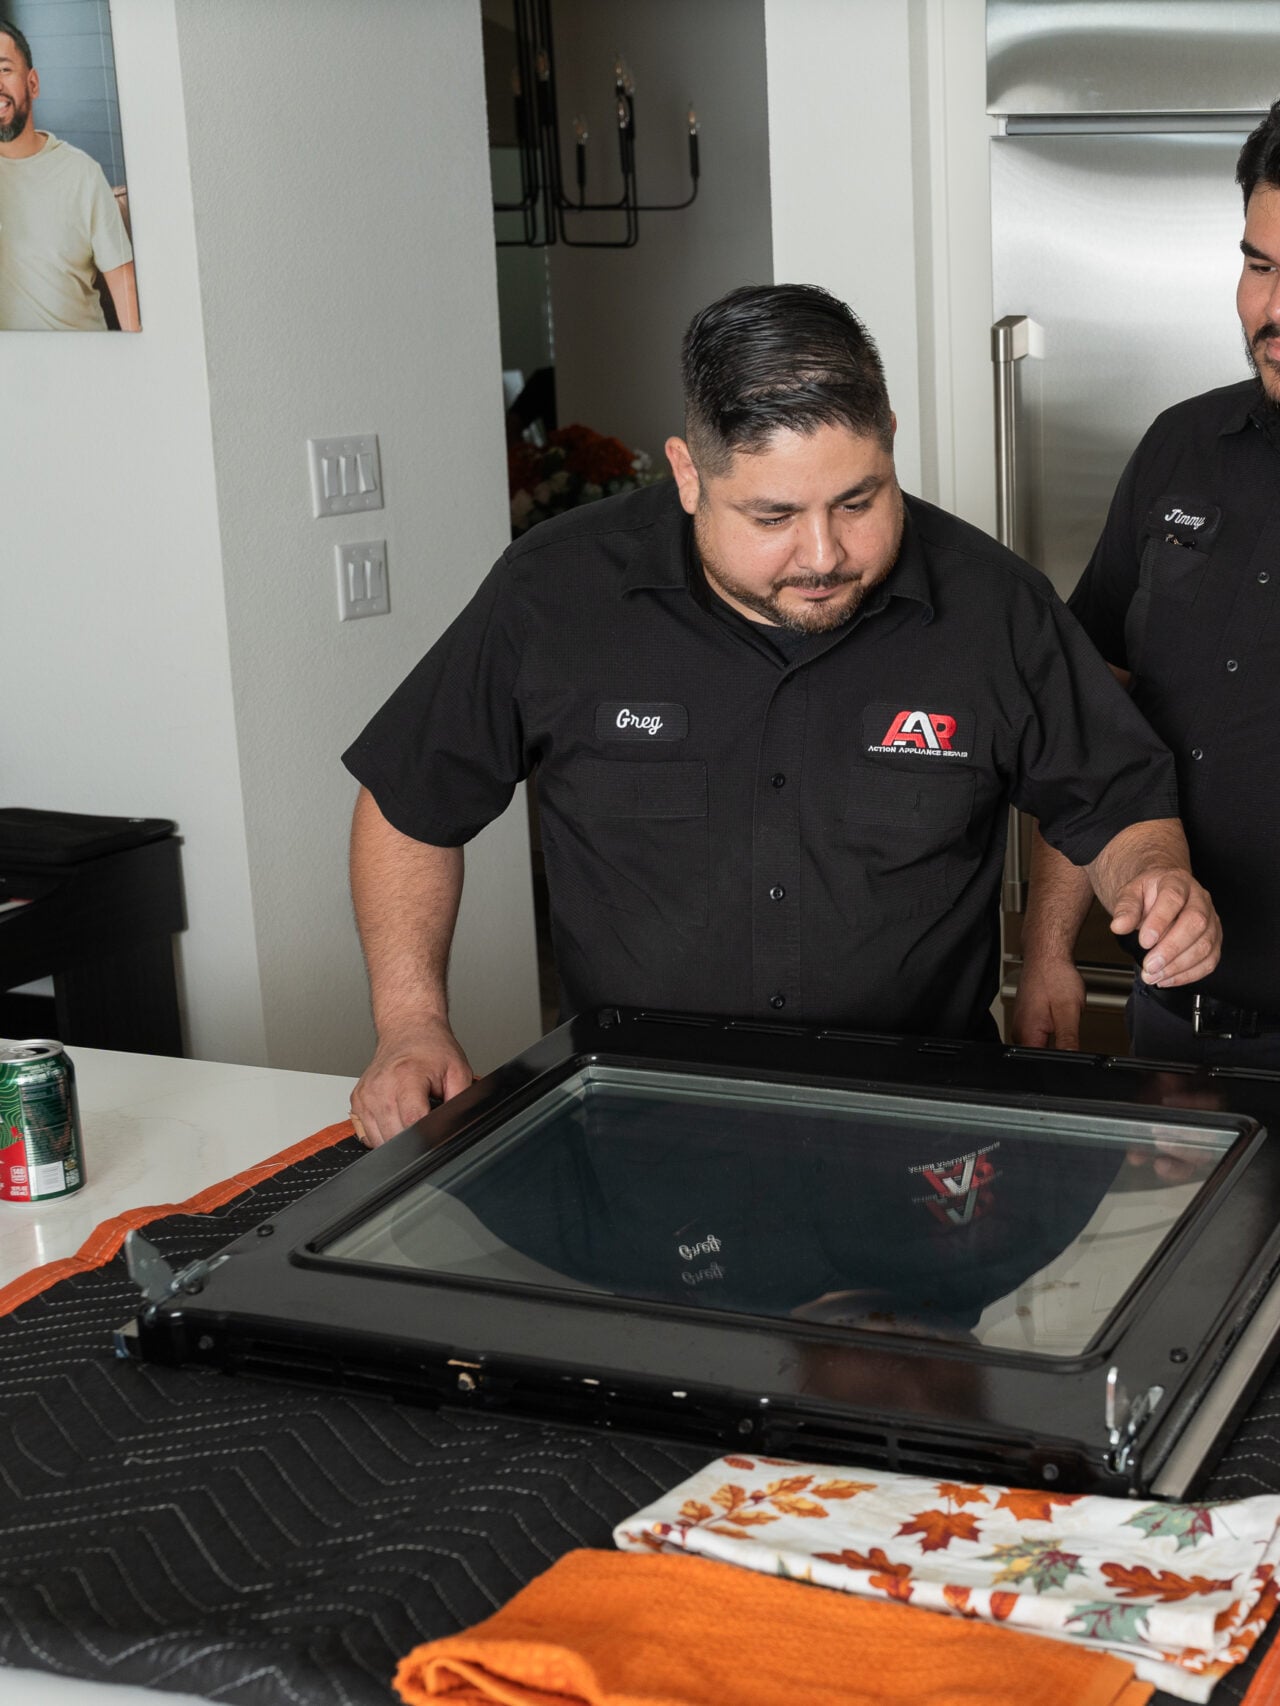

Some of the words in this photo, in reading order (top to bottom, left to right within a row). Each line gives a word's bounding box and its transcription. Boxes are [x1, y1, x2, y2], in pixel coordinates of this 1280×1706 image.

[1164, 508, 1206, 530] Jimmy
[616, 708, 663, 735] Greg
[881, 710, 957, 750] AAR
[868, 744, 897, 753] ACTION
[898, 746, 942, 756] APPLIANCE
[942, 750, 968, 758] REPAIR
